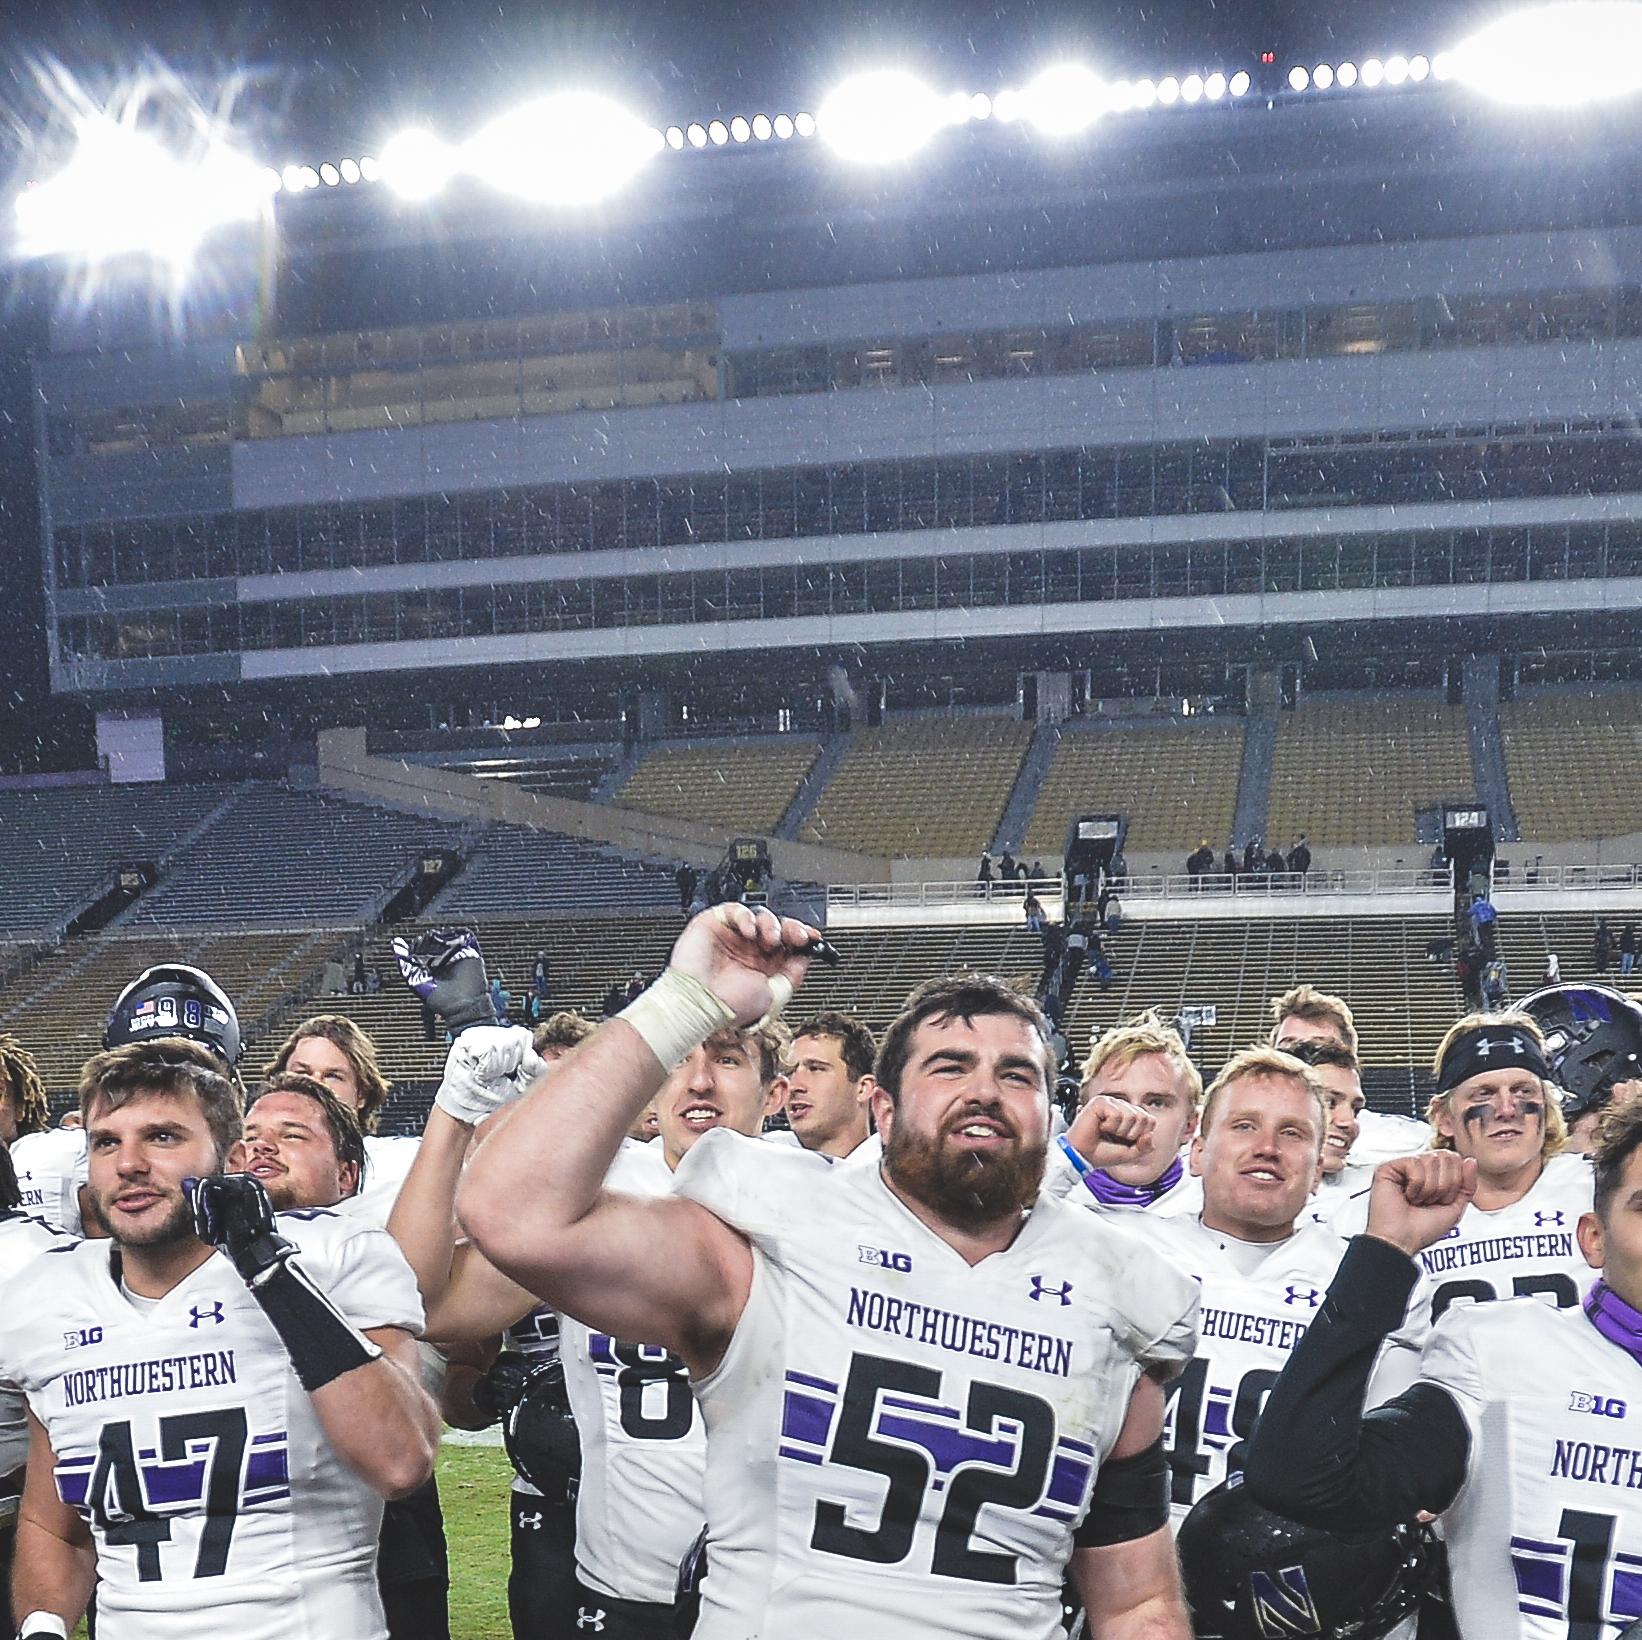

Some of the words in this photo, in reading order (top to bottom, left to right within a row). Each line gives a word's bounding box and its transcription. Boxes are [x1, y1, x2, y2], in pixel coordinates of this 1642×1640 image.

[158, 997, 202, 1028] 98
[1421, 1232, 1573, 1275] NORTHWESTERN
[847, 1287, 1073, 1377] NORTHWESTERN
[63, 1351, 236, 1407] NORTHWESTERN
[85, 1407, 248, 1582] 47
[810, 1352, 1058, 1584] 52
